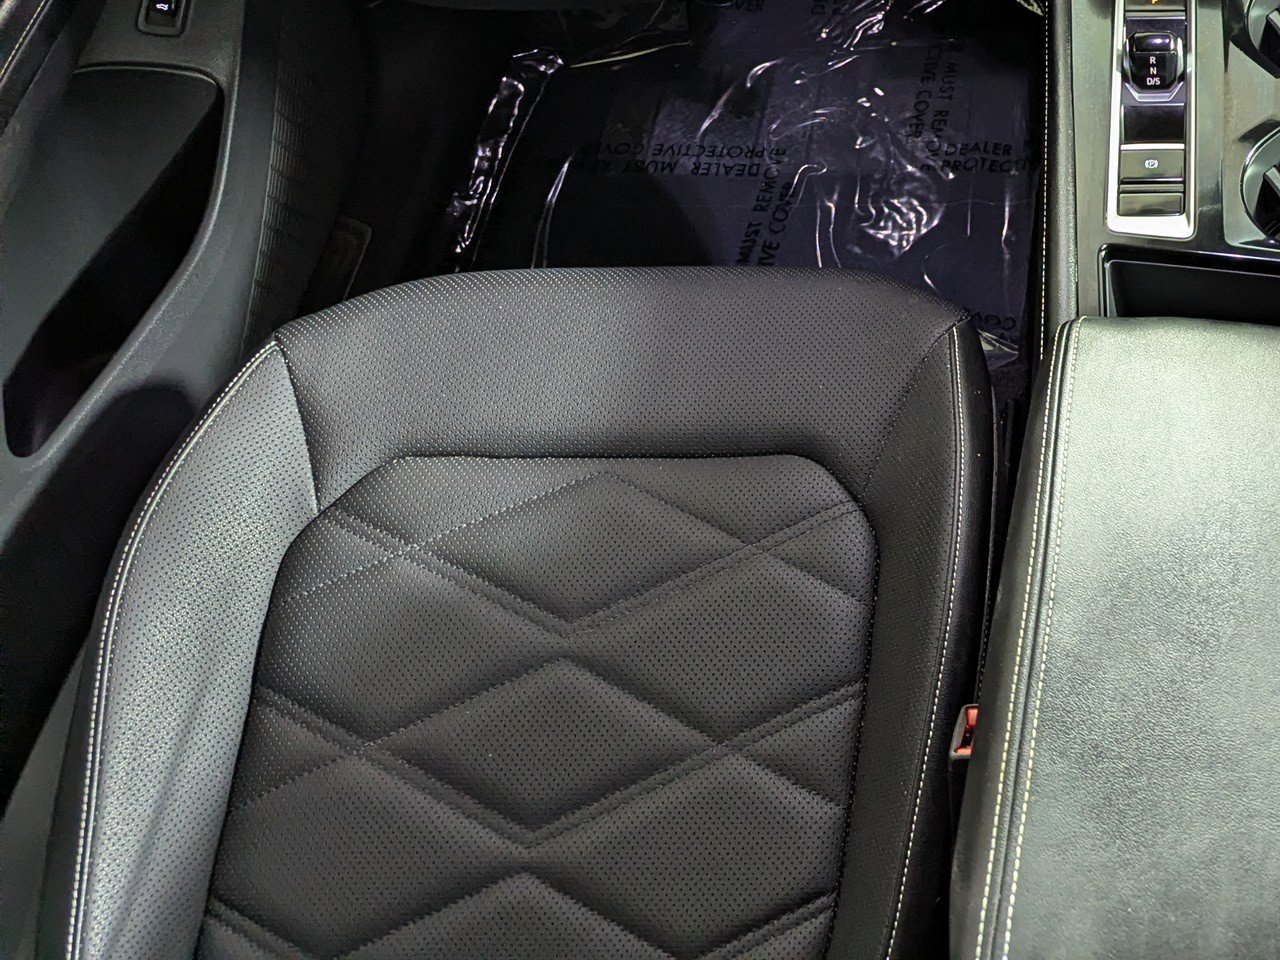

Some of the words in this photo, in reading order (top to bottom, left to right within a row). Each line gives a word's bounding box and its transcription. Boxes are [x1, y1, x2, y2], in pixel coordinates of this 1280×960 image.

[1149, 56, 1157, 64] R
[1149, 66, 1157, 75] N
[1146, 77, 1161, 86] D/S
[652, 141, 766, 159] PROTECTIVE
[944, 142, 1013, 158] DEALER
[690, 160, 760, 178] DEALER
